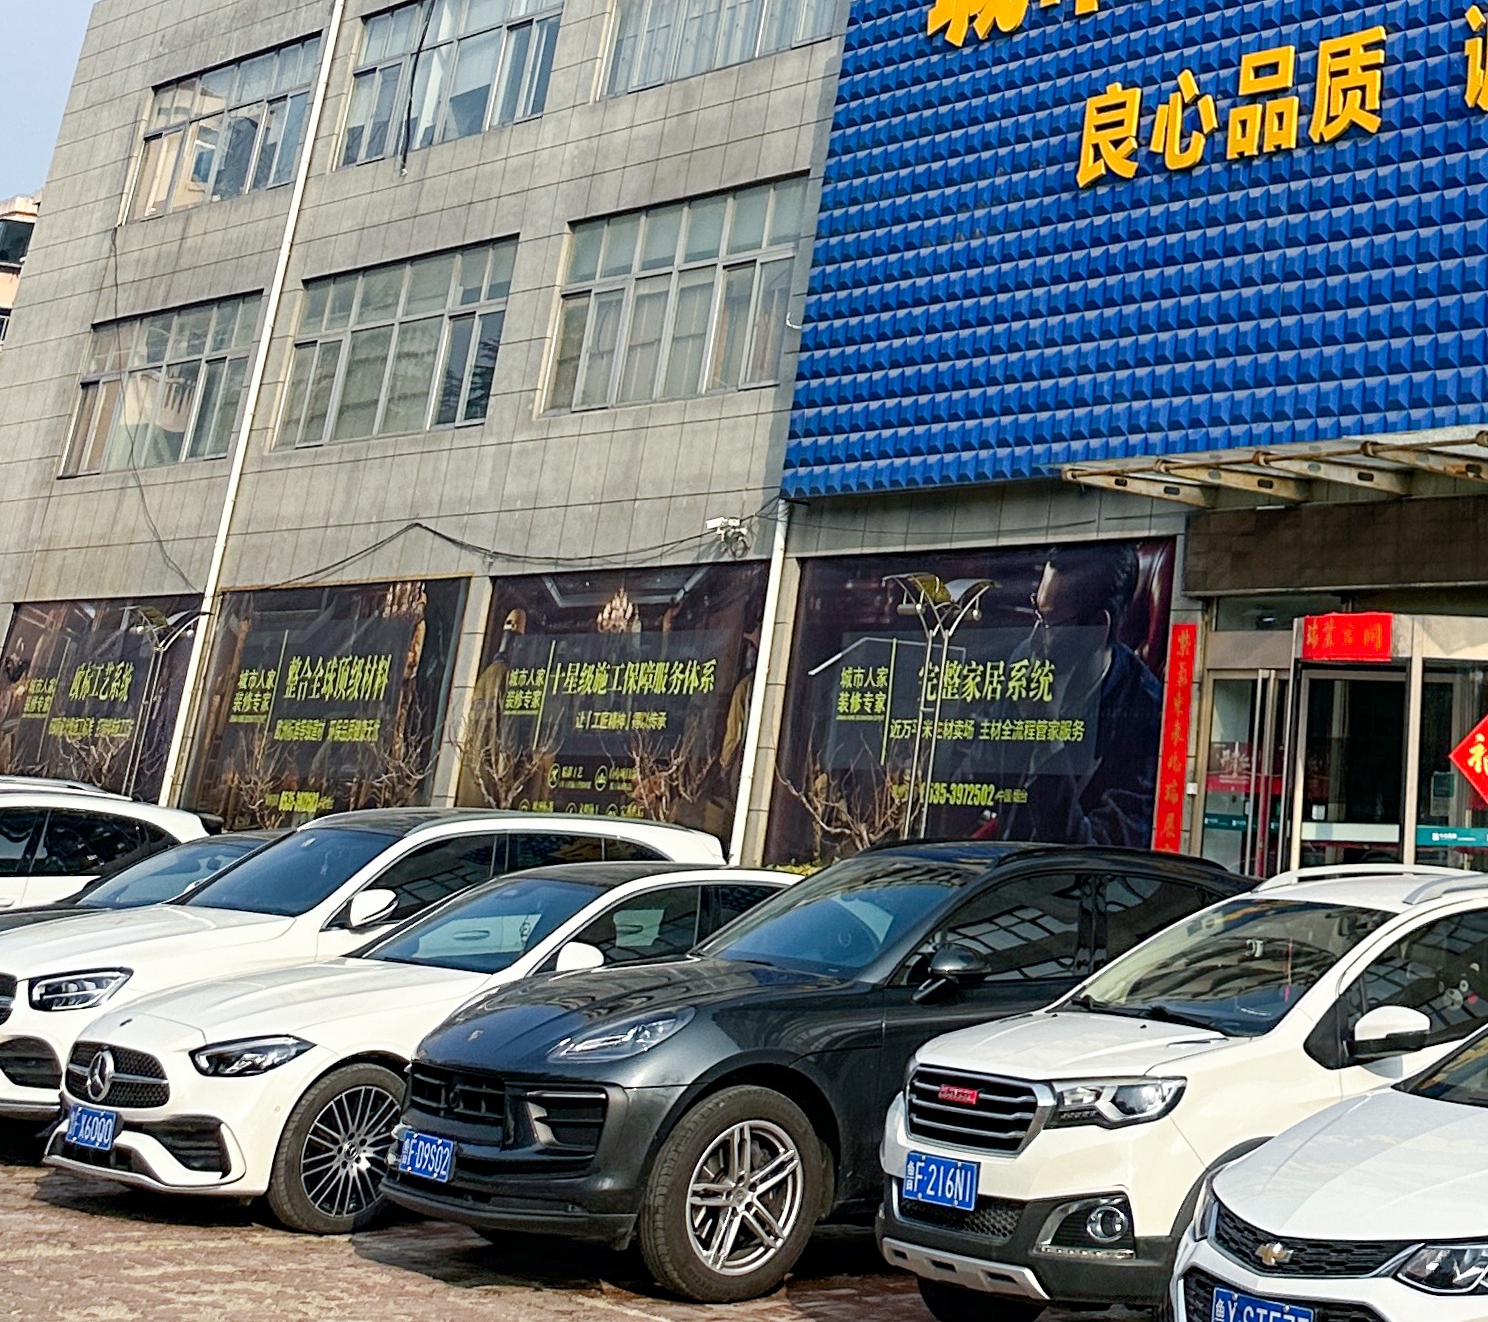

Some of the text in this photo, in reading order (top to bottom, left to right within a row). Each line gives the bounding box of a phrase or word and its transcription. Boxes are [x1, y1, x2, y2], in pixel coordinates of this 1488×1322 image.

[1076, 26, 1385, 188] 良心品质
[237, 668, 277, 690] 城市人家
[282, 653, 393, 702] 整合全球顶级材料
[508, 668, 547, 687] 城市人家
[550, 658, 718, 696] 十星级施工保障服务体系
[839, 666, 889, 689] 城市人家
[918, 658, 1056, 703] 完整家居系统
[231, 692, 272, 713] 装修专家
[504, 689, 543, 710] 装修专家
[836, 691, 887, 714] 装修专家
